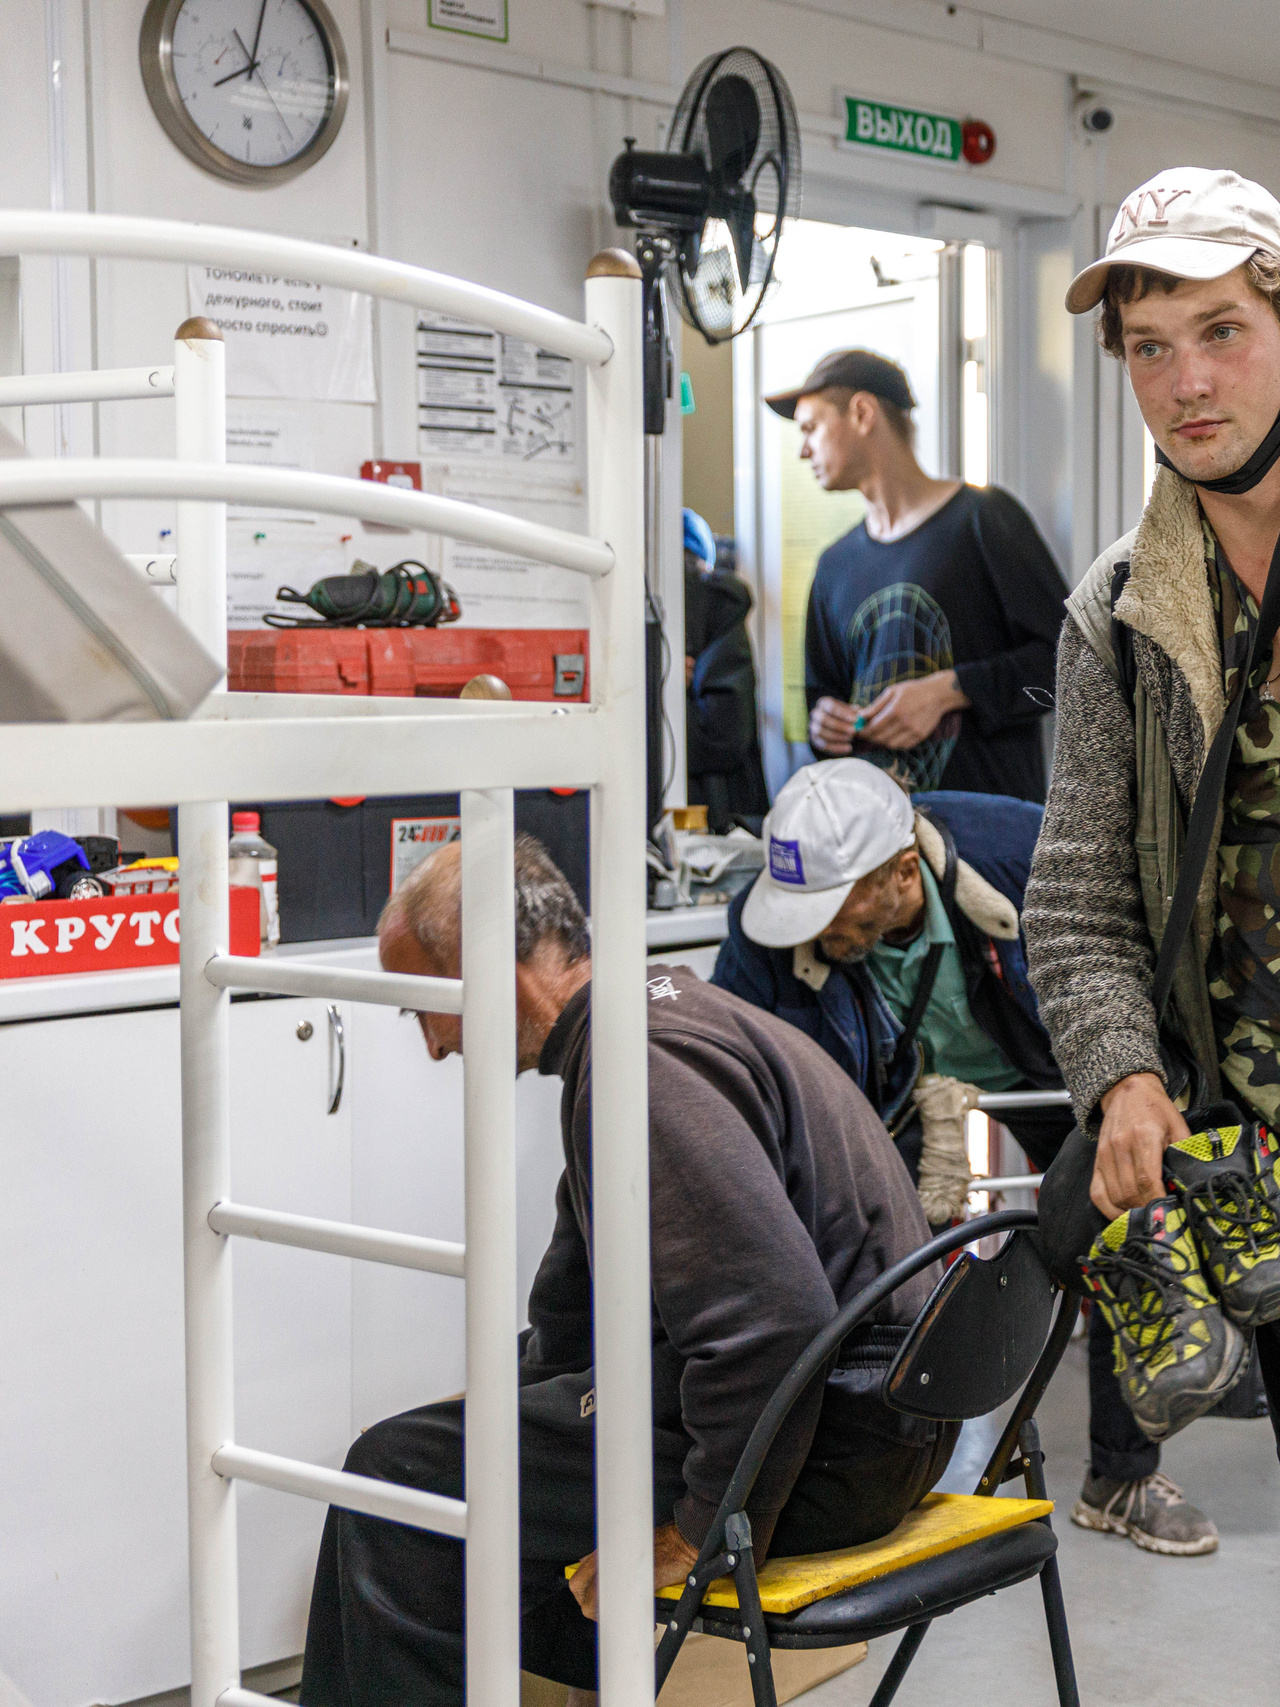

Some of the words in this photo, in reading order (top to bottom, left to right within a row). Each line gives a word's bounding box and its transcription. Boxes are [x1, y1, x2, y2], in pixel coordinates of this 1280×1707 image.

[856, 104, 953, 157] ВЫХОД
[1114, 188, 1191, 242] NY
[205, 292, 285, 311] дежурного,
[288, 299, 323, 313] стоит
